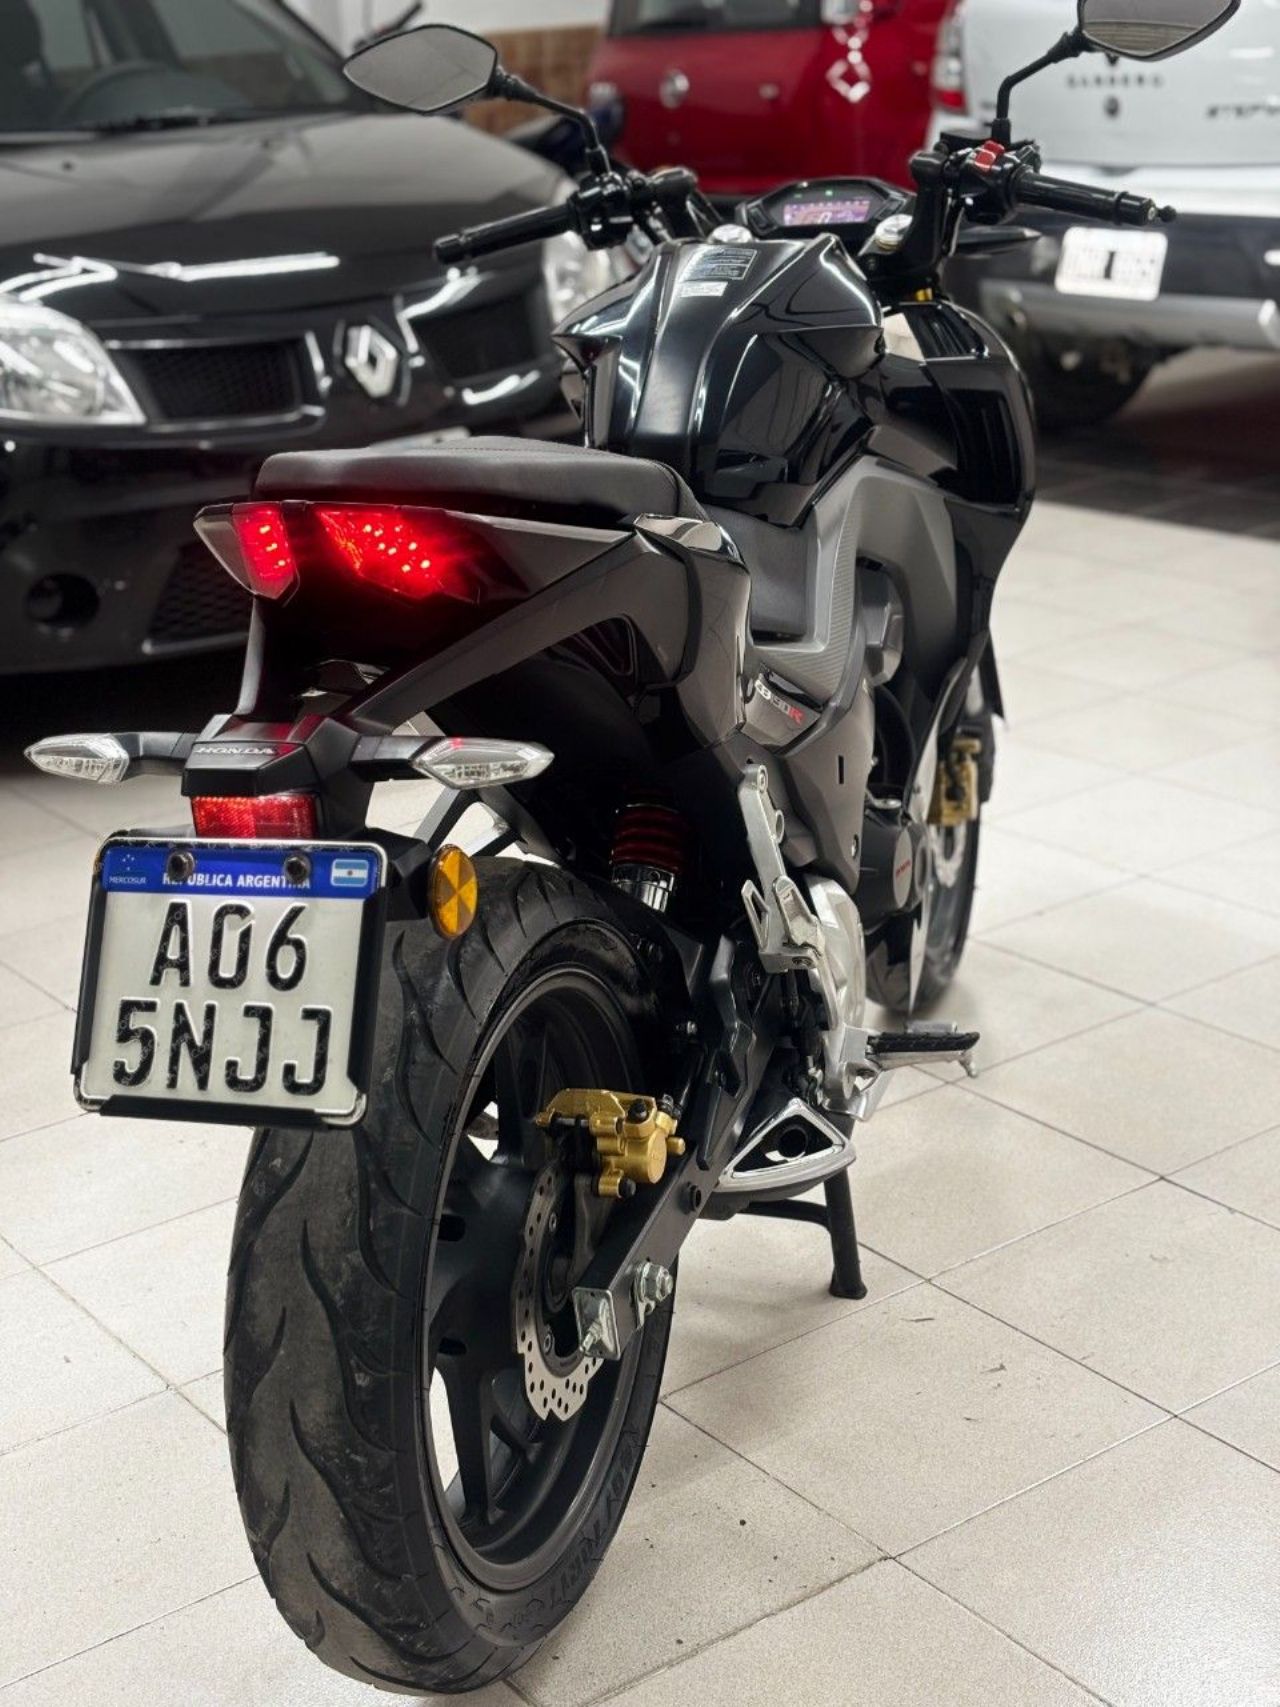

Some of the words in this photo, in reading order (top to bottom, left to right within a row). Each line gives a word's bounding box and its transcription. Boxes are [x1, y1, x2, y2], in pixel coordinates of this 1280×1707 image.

[194, 747, 276, 755] HONDA
[109, 876, 146, 885] MERCOSUR
[162, 872, 233, 888] RUBLICA
[149, 901, 308, 992] A06
[112, 998, 333, 1096] 5NJJ
